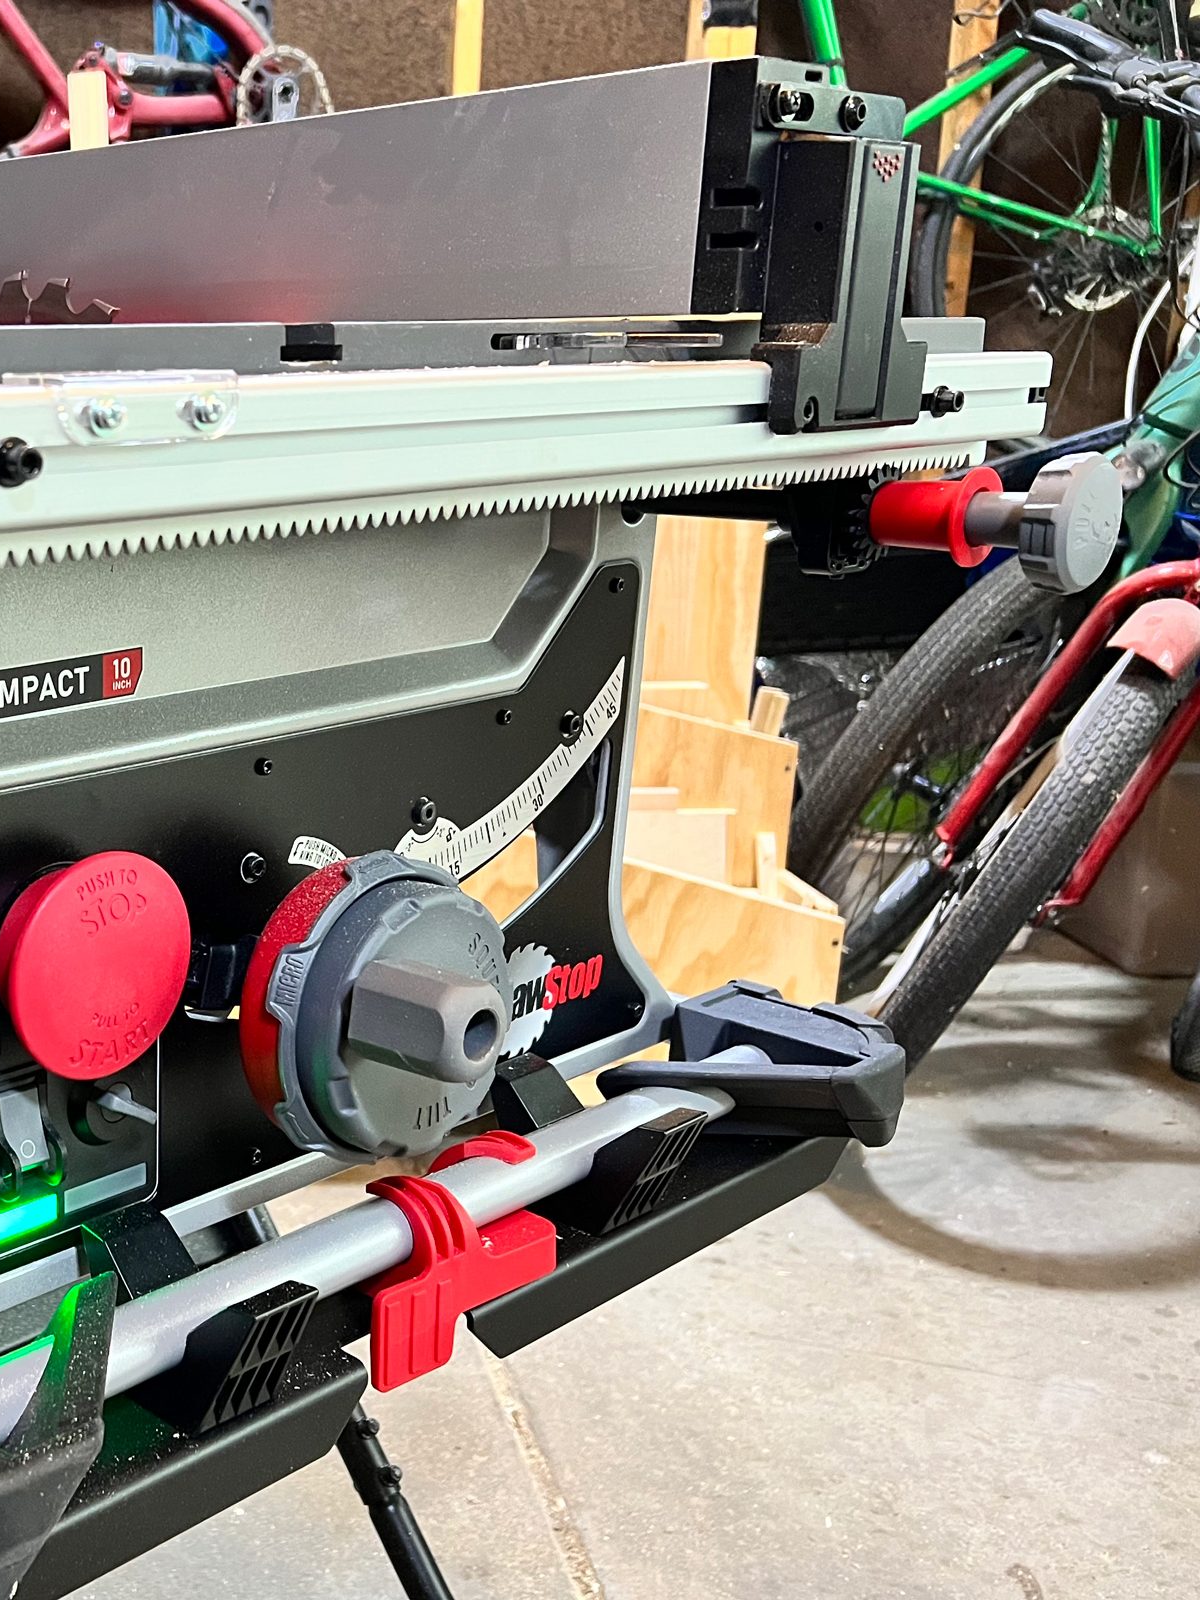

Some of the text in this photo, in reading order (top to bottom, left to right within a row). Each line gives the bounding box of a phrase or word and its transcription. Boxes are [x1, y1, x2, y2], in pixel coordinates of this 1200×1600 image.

[112, 657, 131, 680] 10
[112, 679, 132, 691] INCH
[606, 702, 617, 719] 45
[532, 793, 543, 812] 30
[448, 860, 460, 877] 15
[77, 868, 138, 901] PUSH TO
[80, 892, 148, 937] STOP
[272, 955, 304, 1007] MICRO
[511, 954, 603, 1021] awStop
[92, 1002, 140, 1028] PULL TO
[69, 1017, 150, 1069] START
[412, 1096, 452, 1130] TILT
